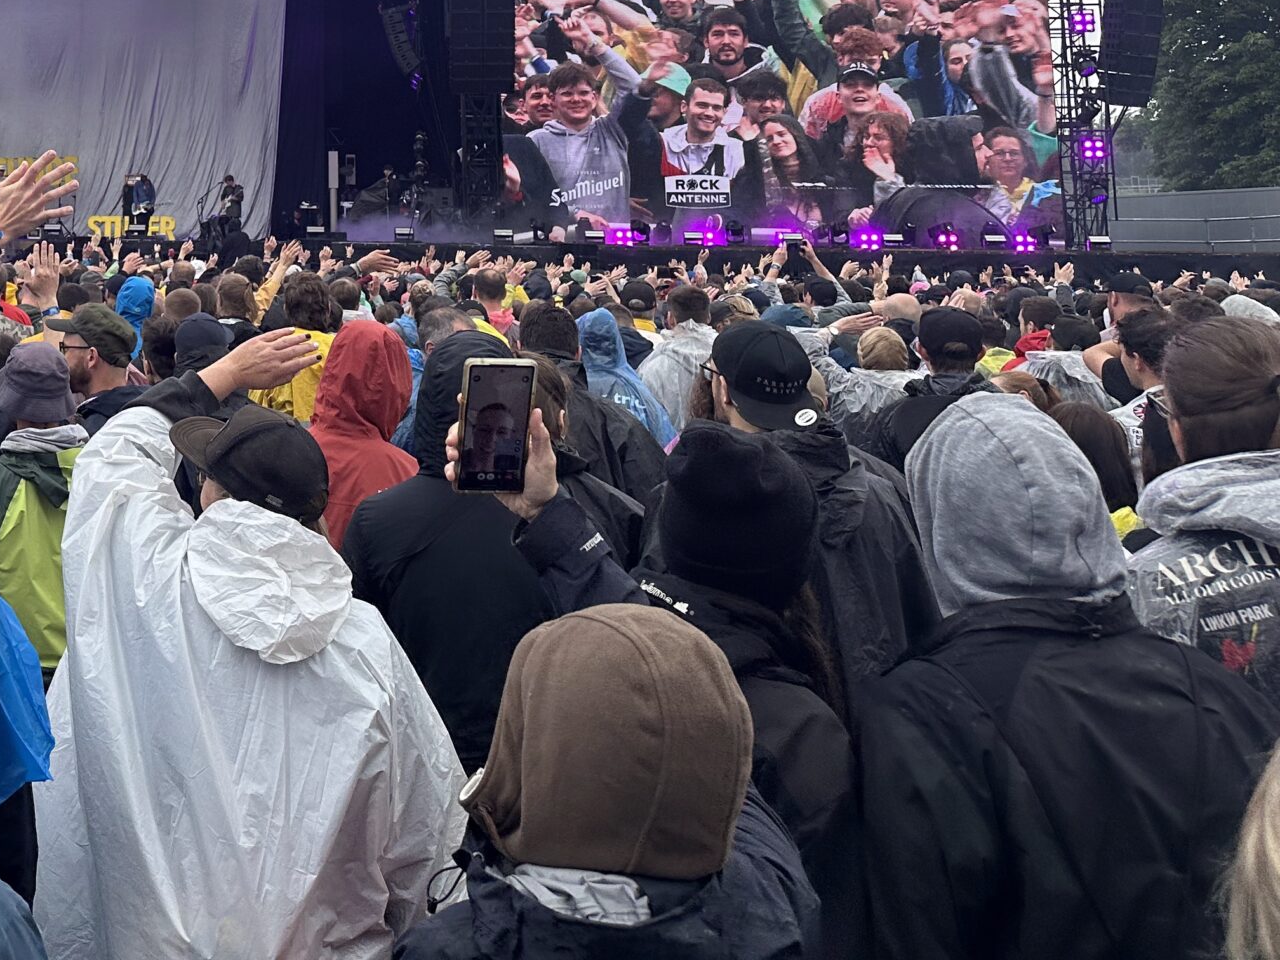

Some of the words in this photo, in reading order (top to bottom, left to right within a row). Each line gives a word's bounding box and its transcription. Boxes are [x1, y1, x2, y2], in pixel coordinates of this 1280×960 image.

[669, 194, 727, 203] ANTENNE
[87, 216, 176, 241] STILER
[1193, 580, 1231, 598] OUR
[1229, 569, 1275, 589] GODS
[1200, 611, 1240, 631] LINKIN
[1237, 603, 1274, 623] PARK
